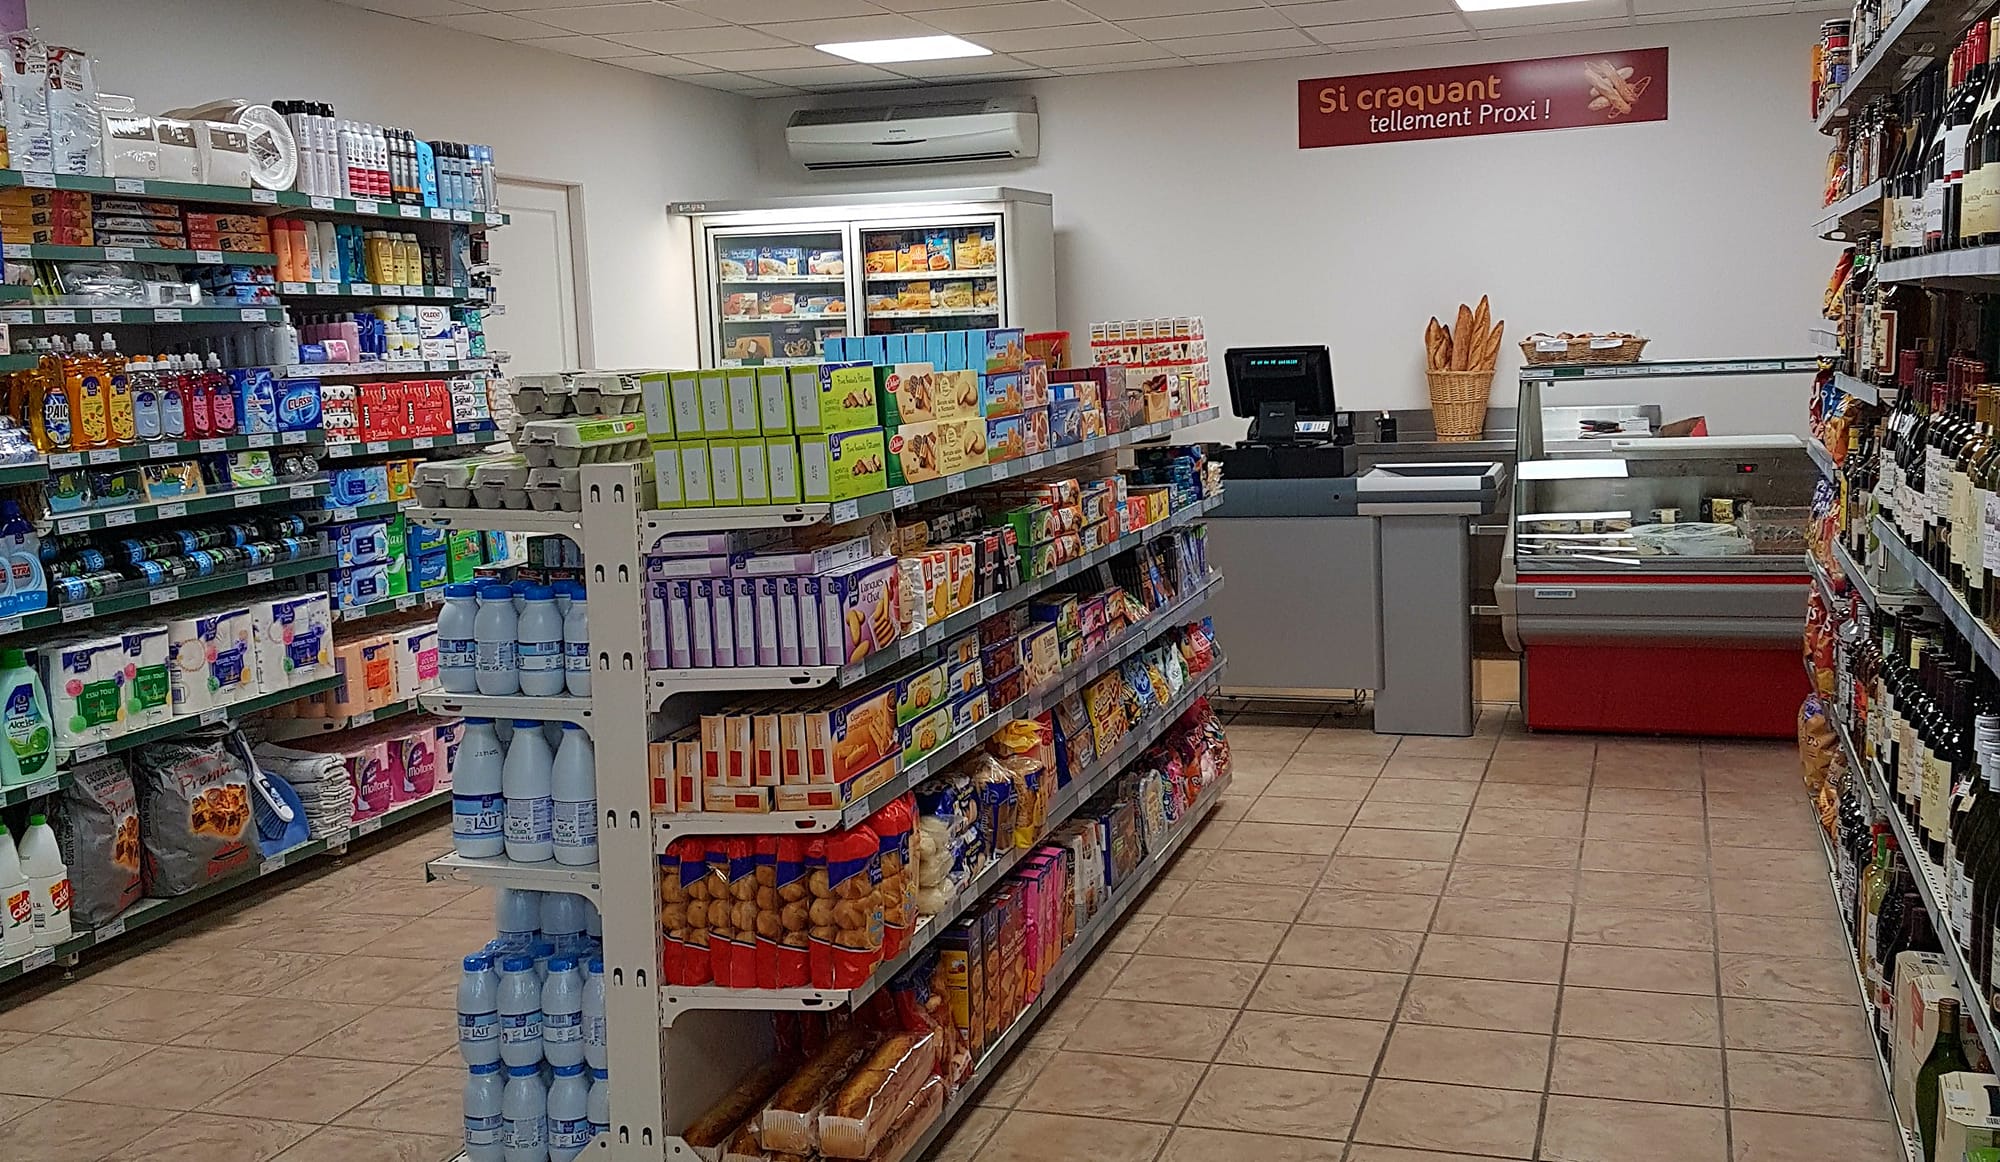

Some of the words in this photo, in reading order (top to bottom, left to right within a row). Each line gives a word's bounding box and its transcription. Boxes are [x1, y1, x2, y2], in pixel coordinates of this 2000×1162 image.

[1318, 85, 1349, 114] Si
[1356, 74, 1502, 112] craquant
[1369, 105, 1472, 134] tellement
[1478, 100, 1538, 124] Proxi
[1543, 99, 1551, 119] !
[453, 381, 472, 392] Signal
[454, 395, 472, 406] Signal
[46, 404, 69, 419] PAIC
[456, 407, 474, 418] Signal
[860, 578, 884, 594] Langues
[867, 591, 880, 604] Chat
[474, 815, 499, 830] LAIT
